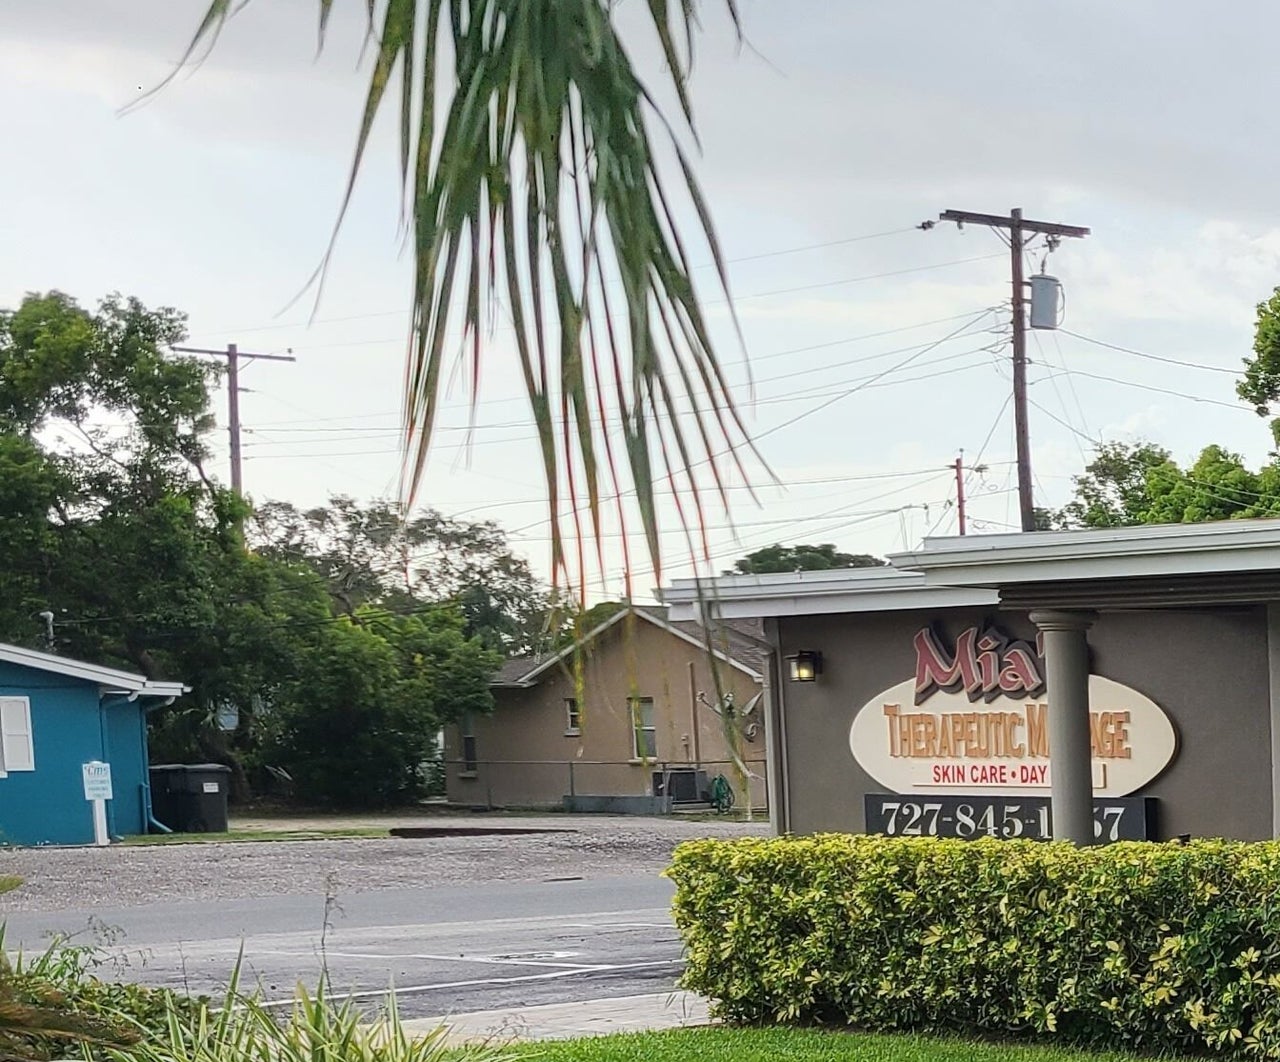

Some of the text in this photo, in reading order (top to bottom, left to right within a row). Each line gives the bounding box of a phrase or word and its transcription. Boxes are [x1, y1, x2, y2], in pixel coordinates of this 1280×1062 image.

[913, 627, 1046, 694] Mia'
[883, 703, 1132, 760] THERAPEUTIC MAGE
[933, 765, 1047, 784] SKIN CARE DAY
[881, 802, 1125, 842] 727-845-17
